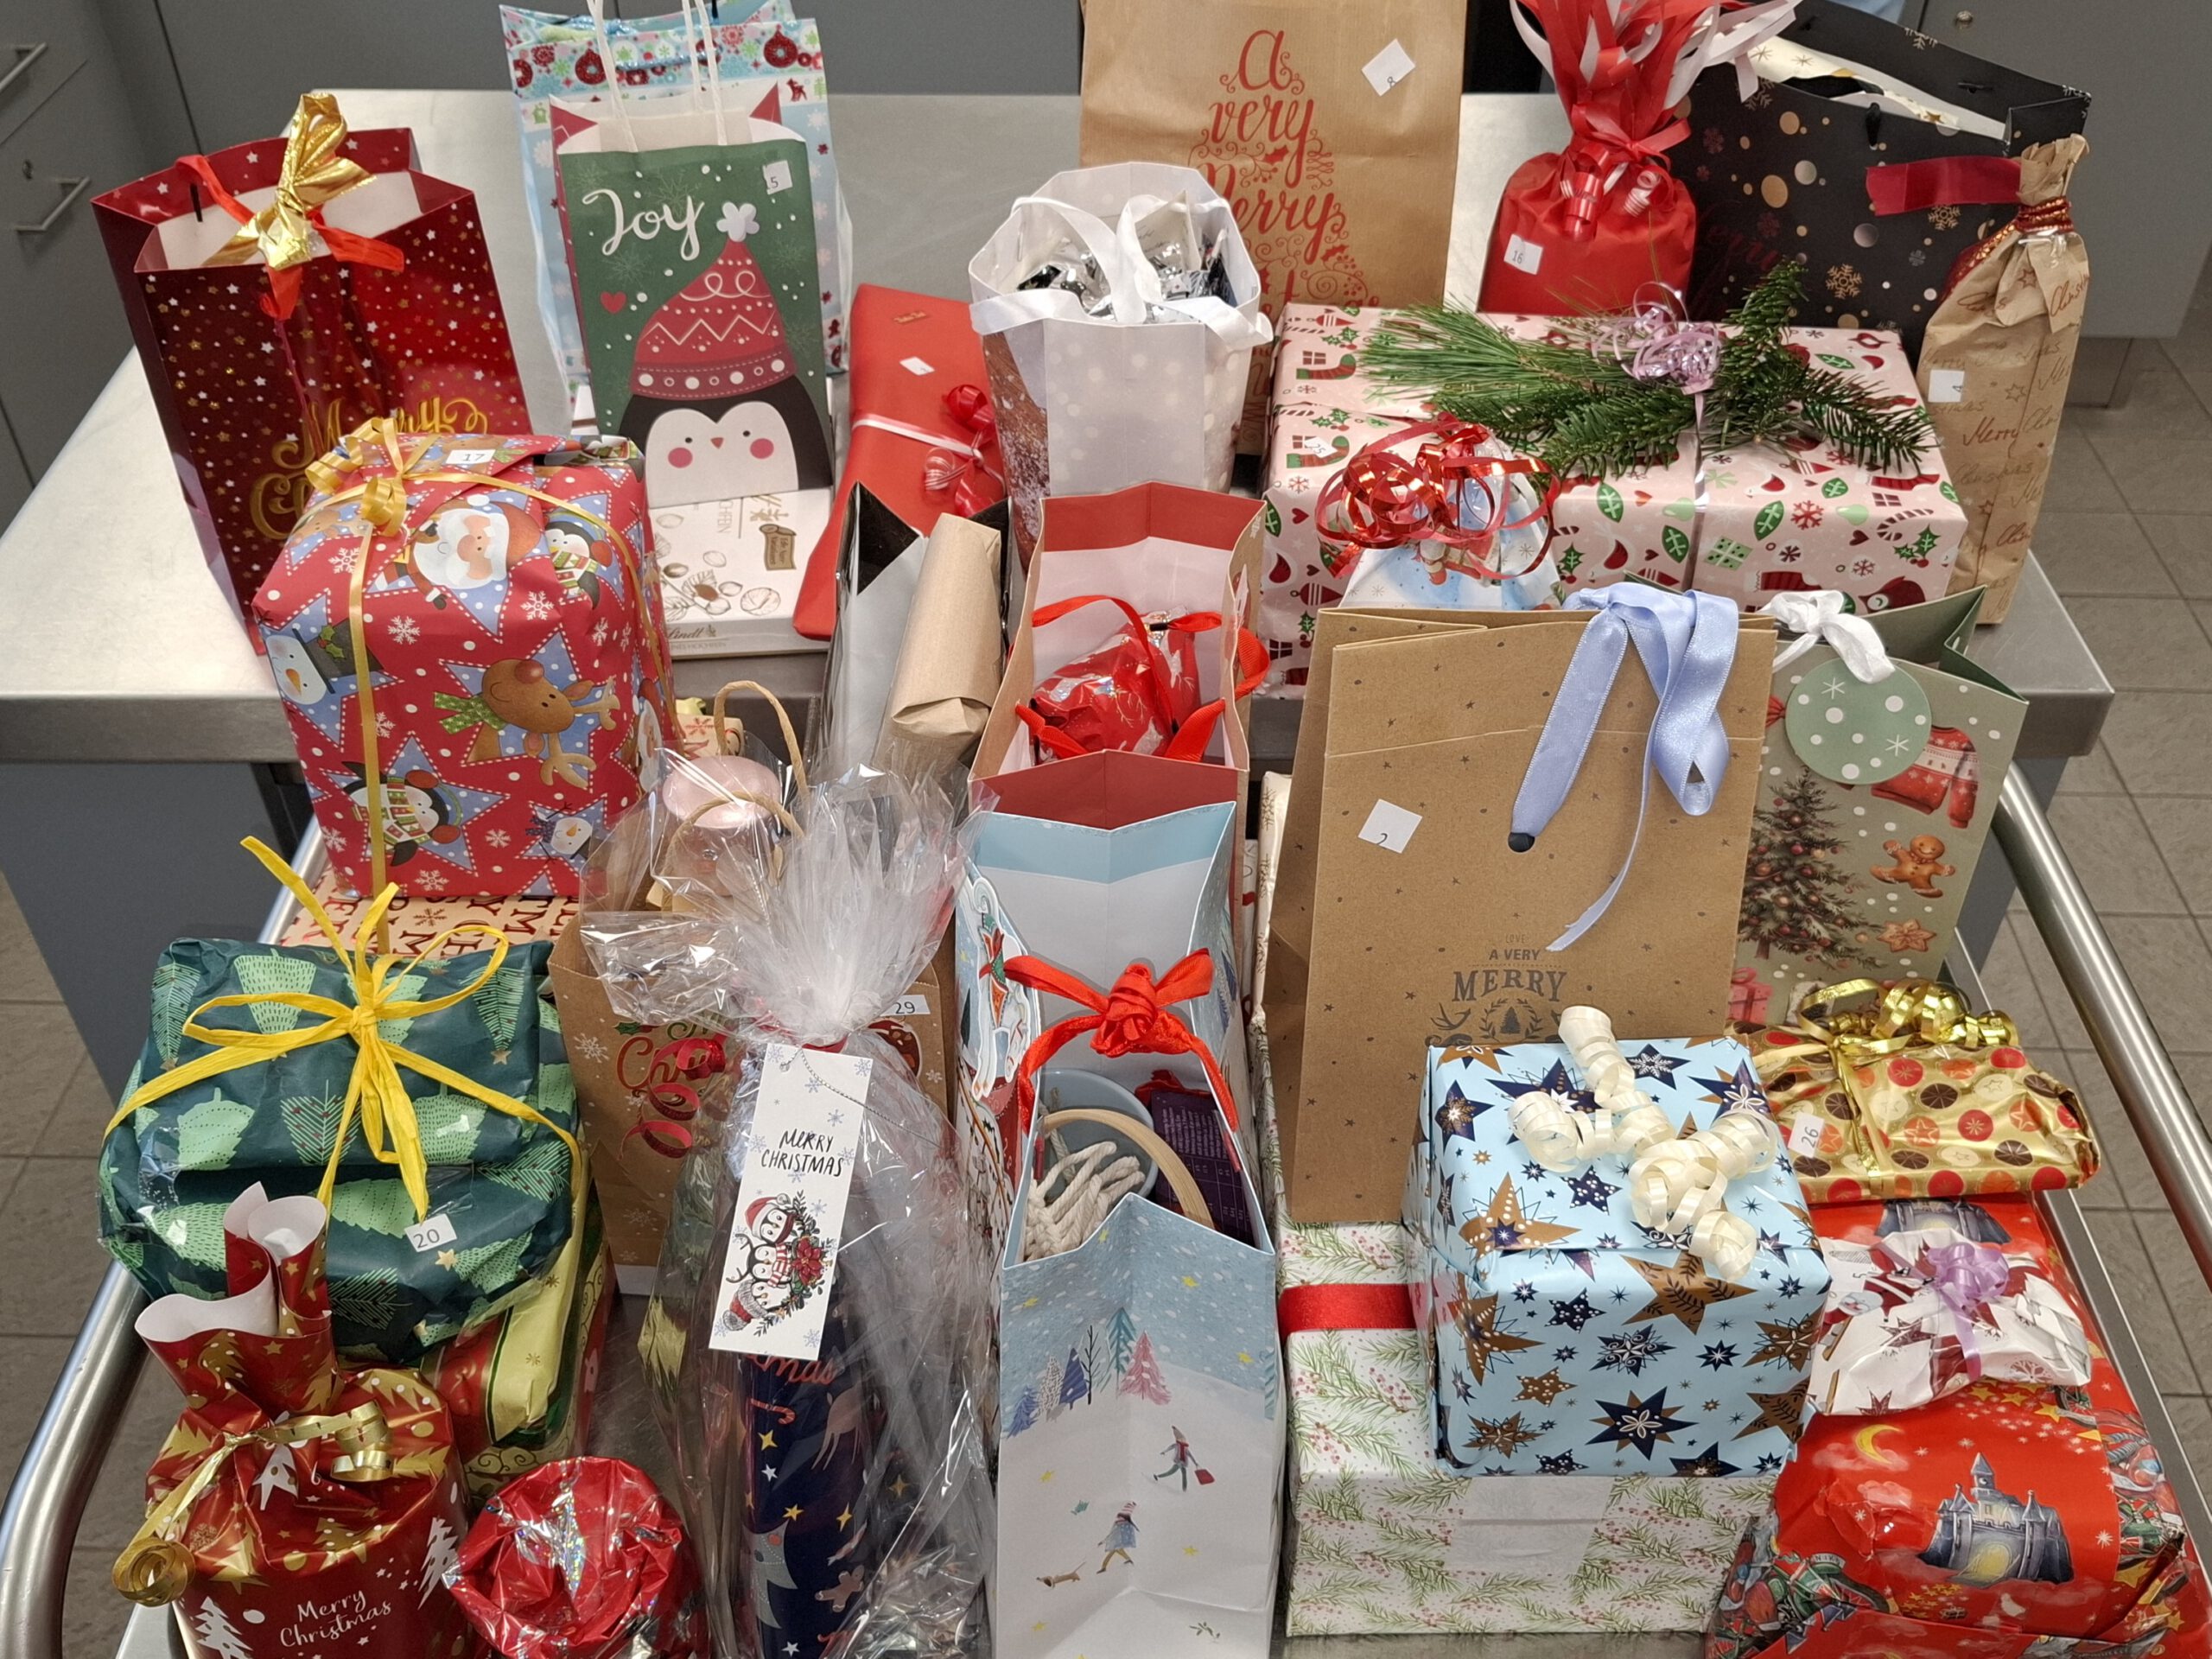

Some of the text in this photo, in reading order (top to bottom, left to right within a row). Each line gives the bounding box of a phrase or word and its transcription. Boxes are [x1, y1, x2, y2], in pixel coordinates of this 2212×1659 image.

[1210, 94, 1315, 188] very
[770, 176, 779, 188] 5
[582, 188, 705, 261] Joy
[1512, 250, 1524, 264] 16
[1963, 416, 2019, 459] Merry
[462, 453, 486, 462] 17
[1489, 949, 1541, 961] A VERY
[1451, 969, 1568, 1003] MERRY
[893, 1001, 916, 1014] 29
[1801, 1126, 1820, 1149] 26
[760, 1148, 845, 1178] CHRISTMAS
[413, 1228, 441, 1249] 20
[296, 1590, 367, 1623] Merry
[279, 1599, 392, 1648] Christmas
